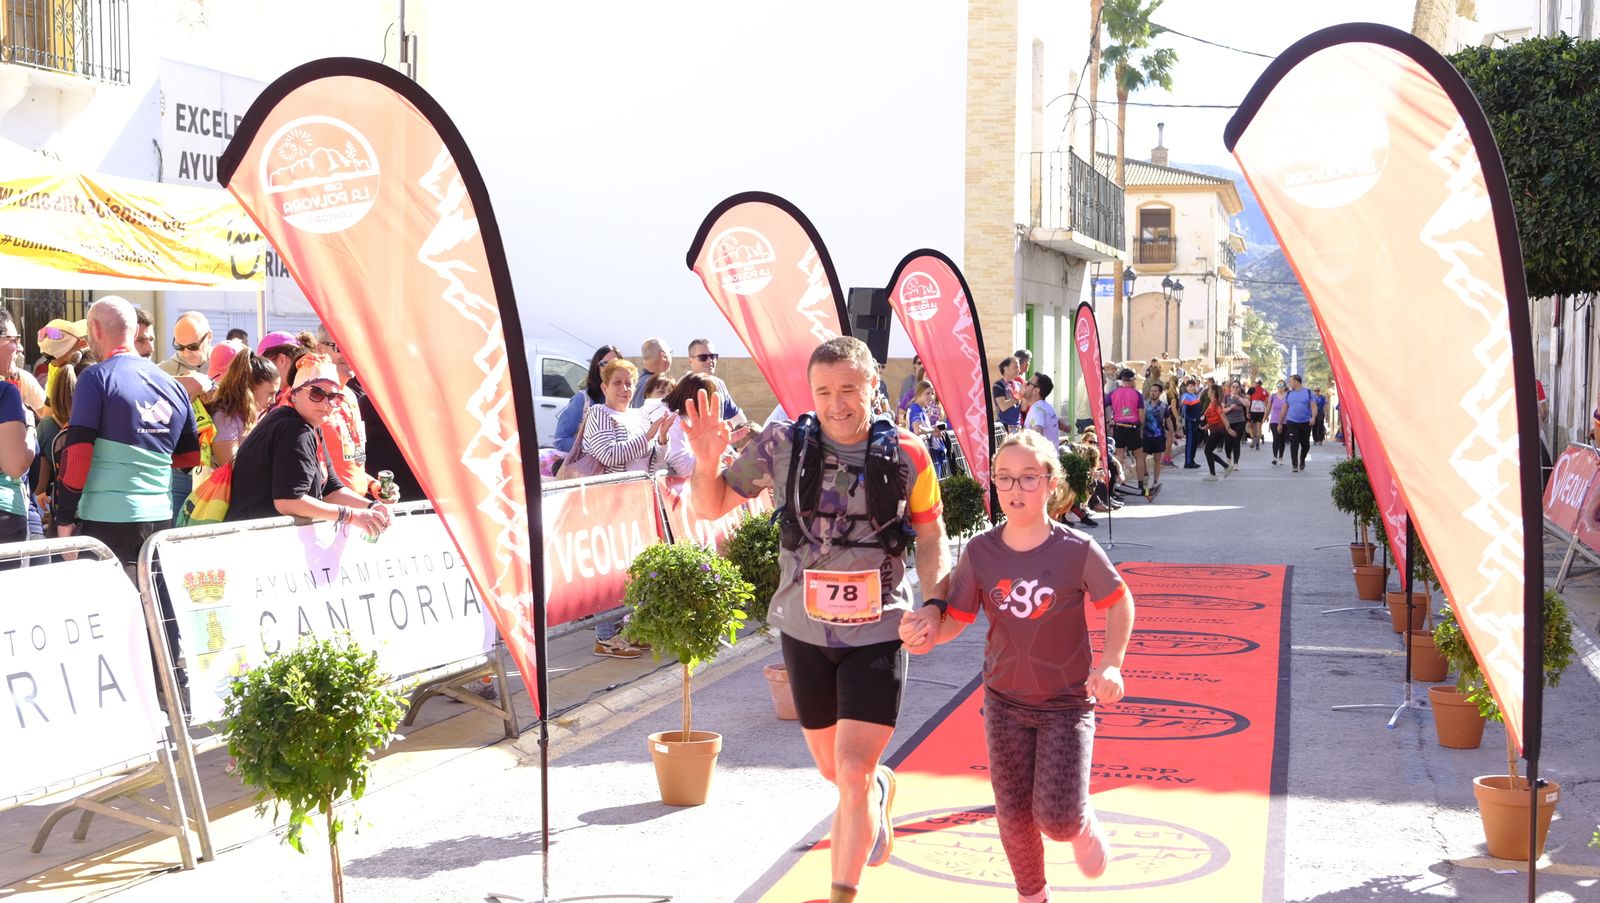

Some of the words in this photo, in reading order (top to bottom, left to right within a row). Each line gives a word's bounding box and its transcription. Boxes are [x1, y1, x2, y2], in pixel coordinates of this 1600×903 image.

[178, 150, 220, 184] AYU
[553, 519, 643, 584] VEOLIA
[255, 553, 434, 599] AYUNTAMIENTO
[825, 583, 858, 602] 78
[64, 613, 104, 645] DE
[259, 576, 482, 657] CANTORIA
[5, 653, 128, 729] RIA
